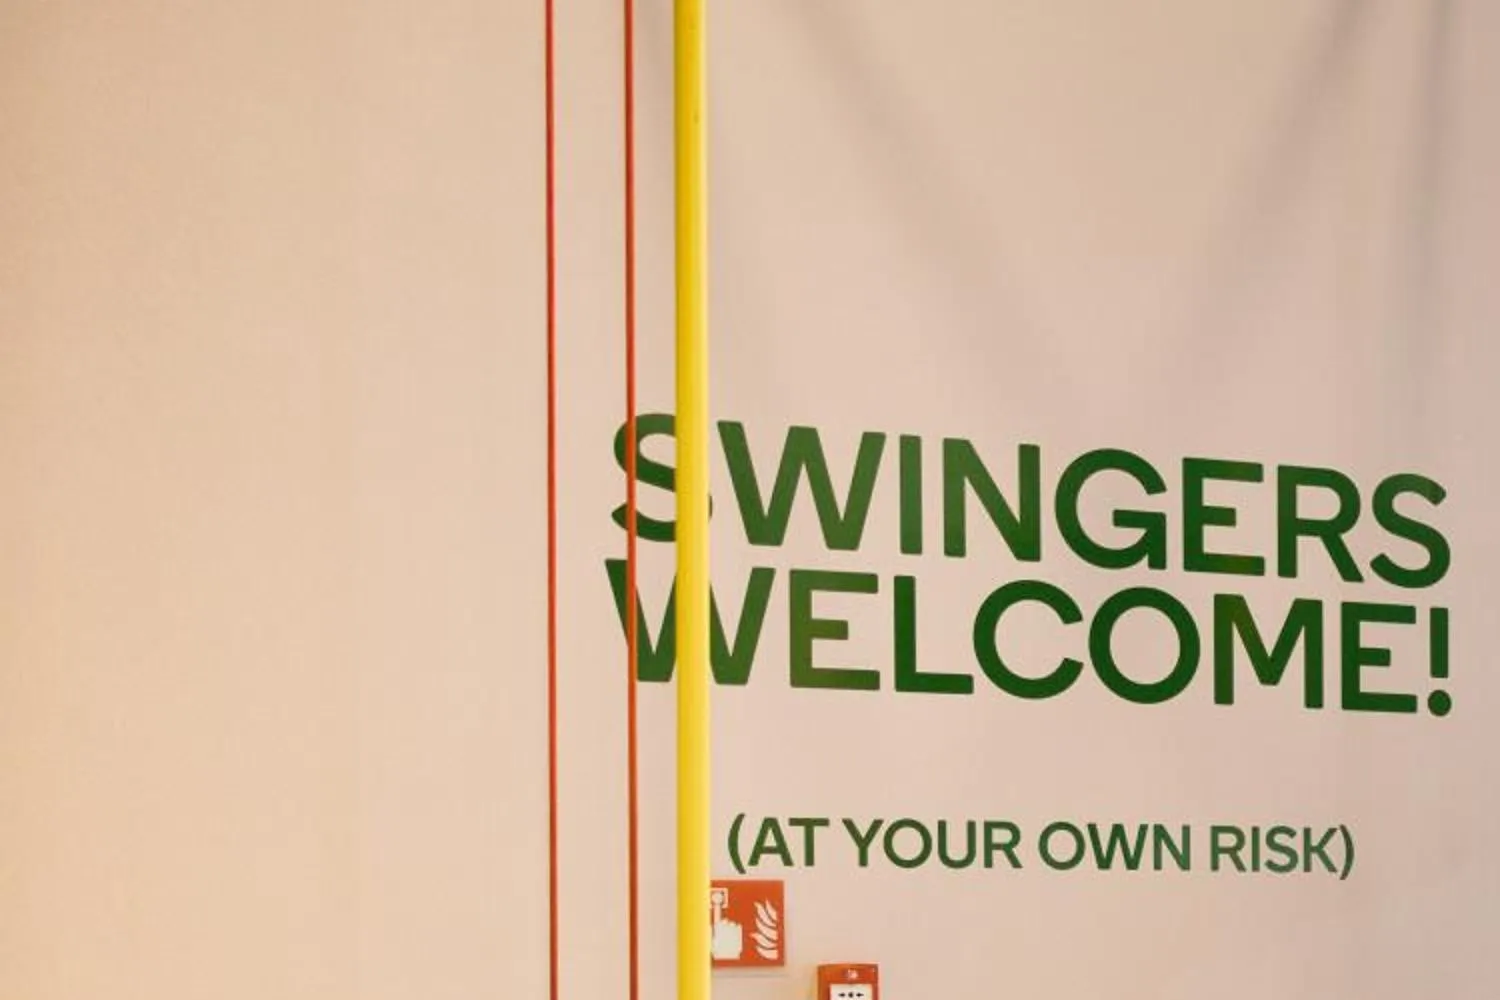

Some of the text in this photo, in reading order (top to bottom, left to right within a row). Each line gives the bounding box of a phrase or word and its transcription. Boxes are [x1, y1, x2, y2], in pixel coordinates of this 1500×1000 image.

[611, 412, 1452, 590] SWINGERS
[604, 558, 1453, 718] WELCOME!
[727, 813, 1355, 880] (AT YOUR OWN RISK)
